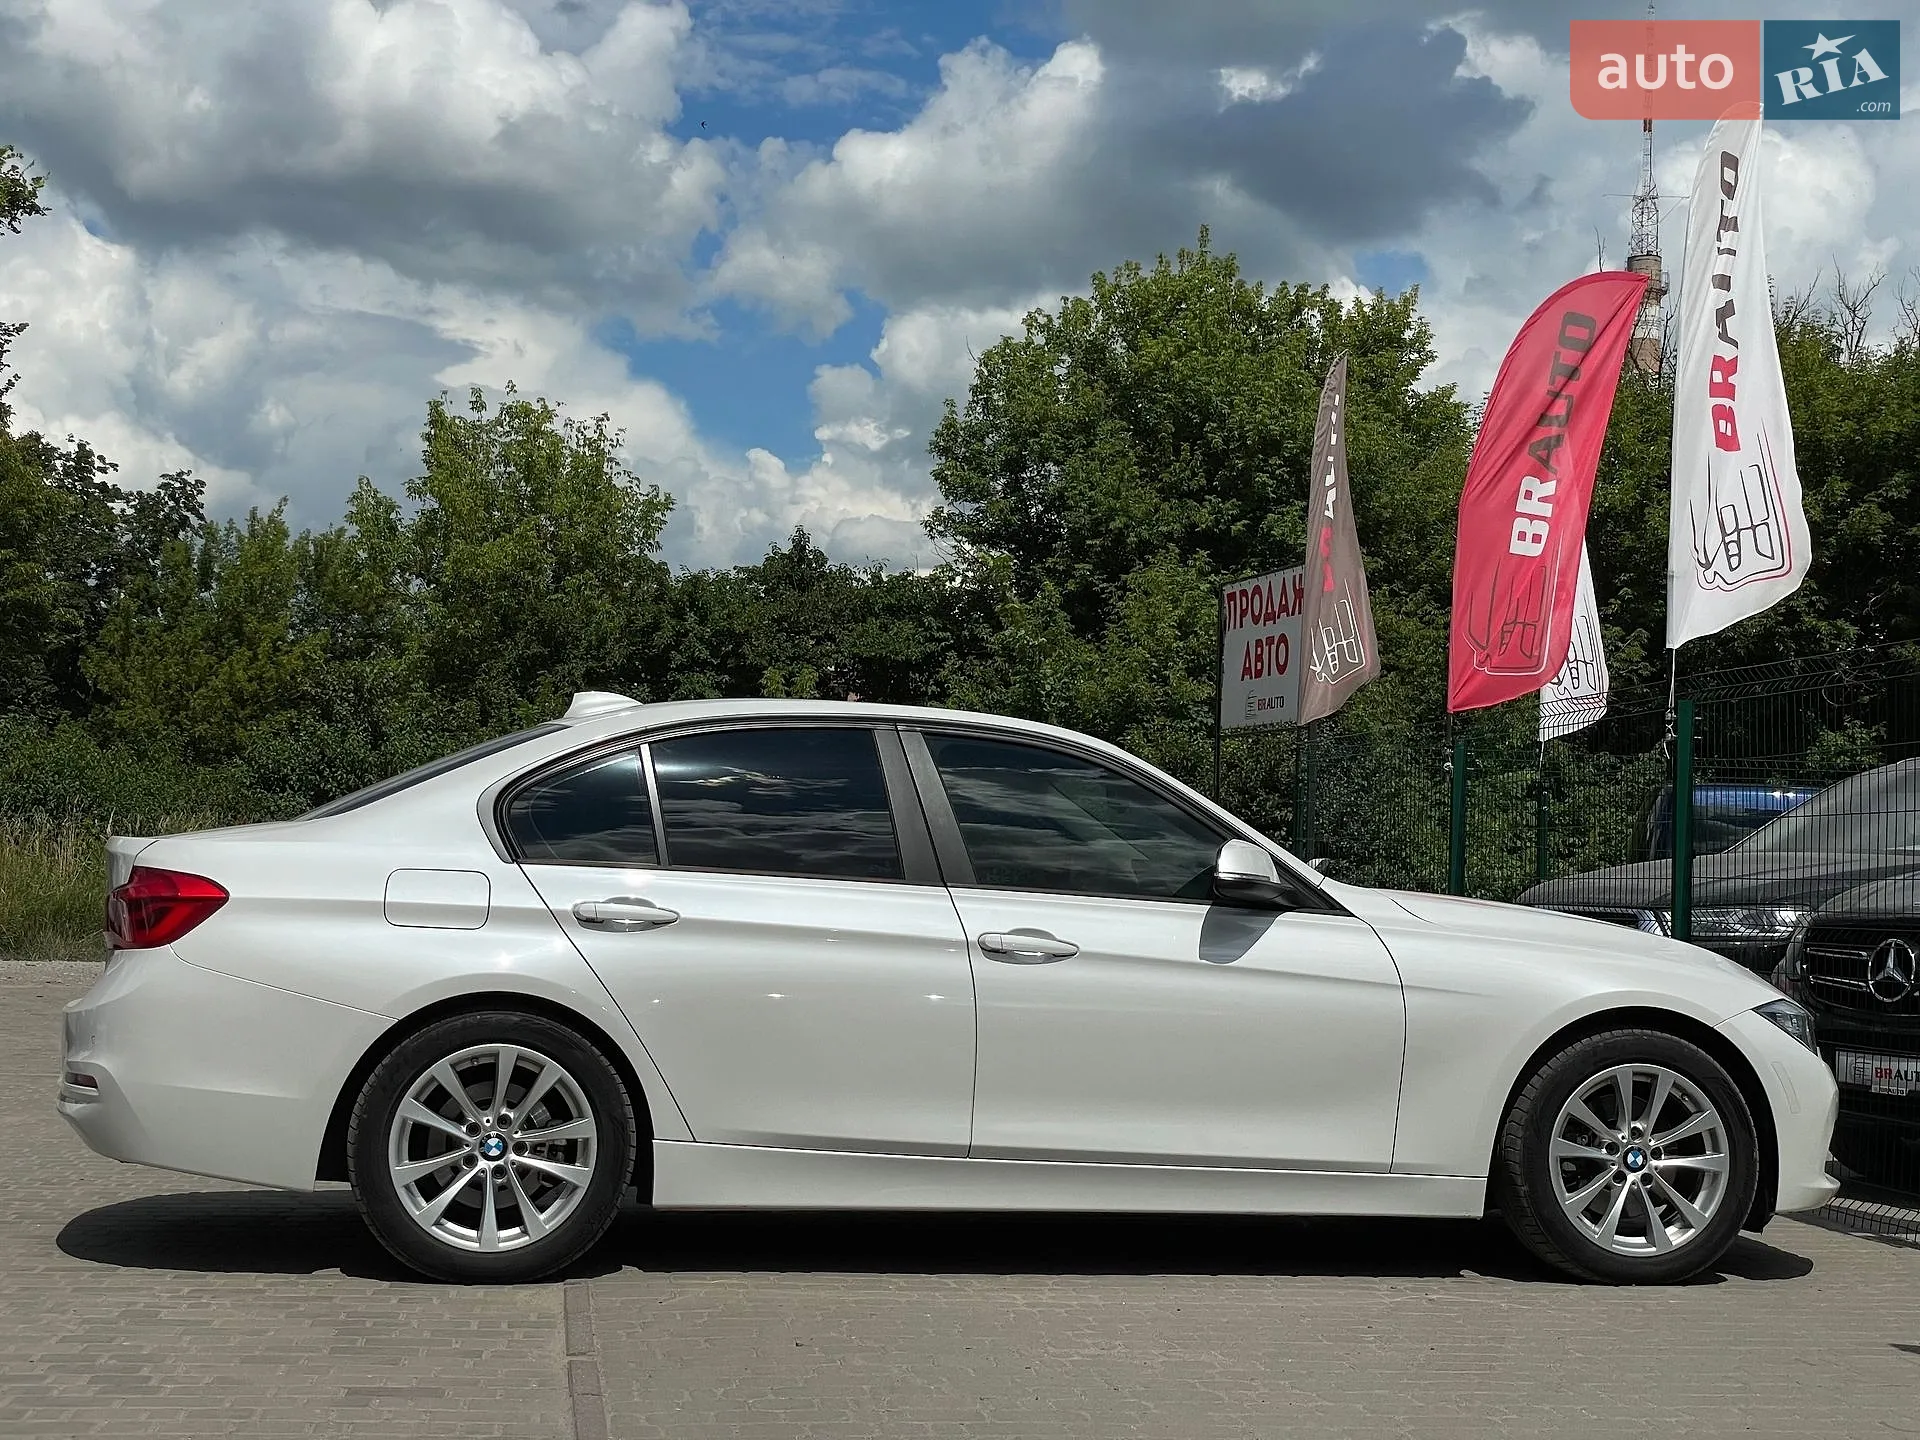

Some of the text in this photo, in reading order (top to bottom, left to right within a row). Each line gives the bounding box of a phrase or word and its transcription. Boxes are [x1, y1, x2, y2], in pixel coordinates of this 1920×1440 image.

[1509, 311, 1597, 557] BRAUTO
[1241, 633, 1289, 681] АВТО
[1257, 695, 1285, 711] BRAUTO
